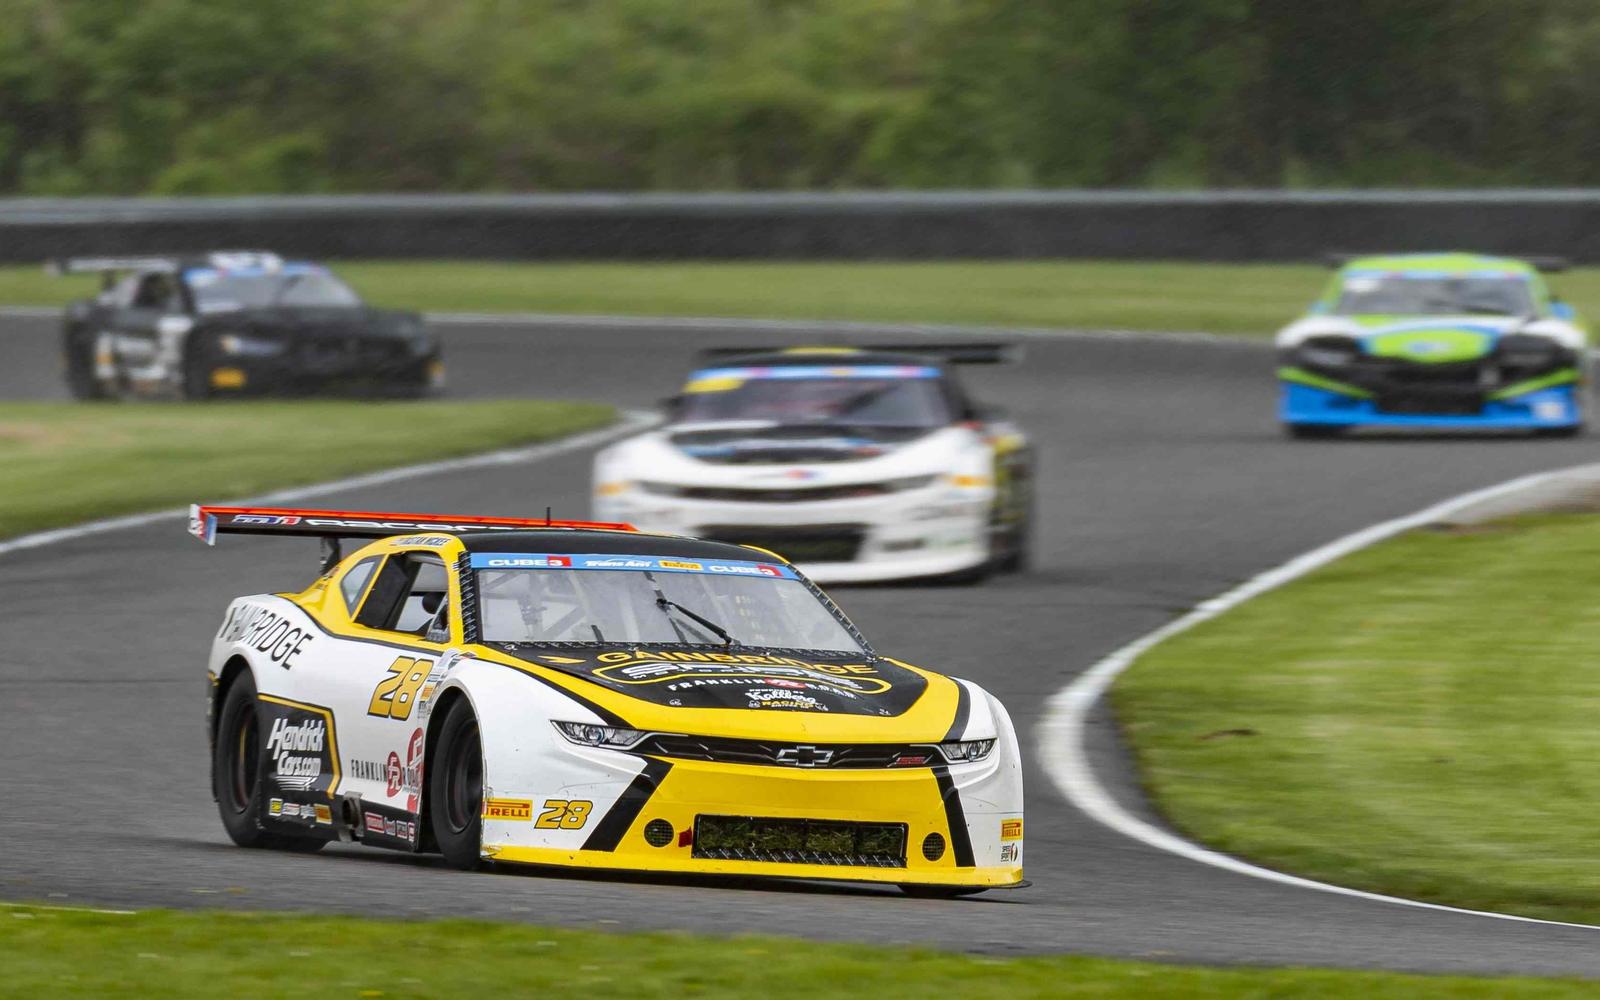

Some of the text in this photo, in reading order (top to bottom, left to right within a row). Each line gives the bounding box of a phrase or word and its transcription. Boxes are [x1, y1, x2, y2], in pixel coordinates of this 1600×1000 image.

[487, 558, 565, 567] CUBE3
[584, 559, 623, 567] Trans
[709, 564, 776, 576] CUBE3
[597, 651, 879, 674] GAINBRIDGE
[367, 656, 434, 721] 28
[668, 678, 766, 692] FRANKLIN
[266, 717, 325, 760] Hendrick
[276, 750, 322, 777] Cars.com
[350, 758, 388, 784] FRANKLIN
[534, 799, 594, 830] 28
